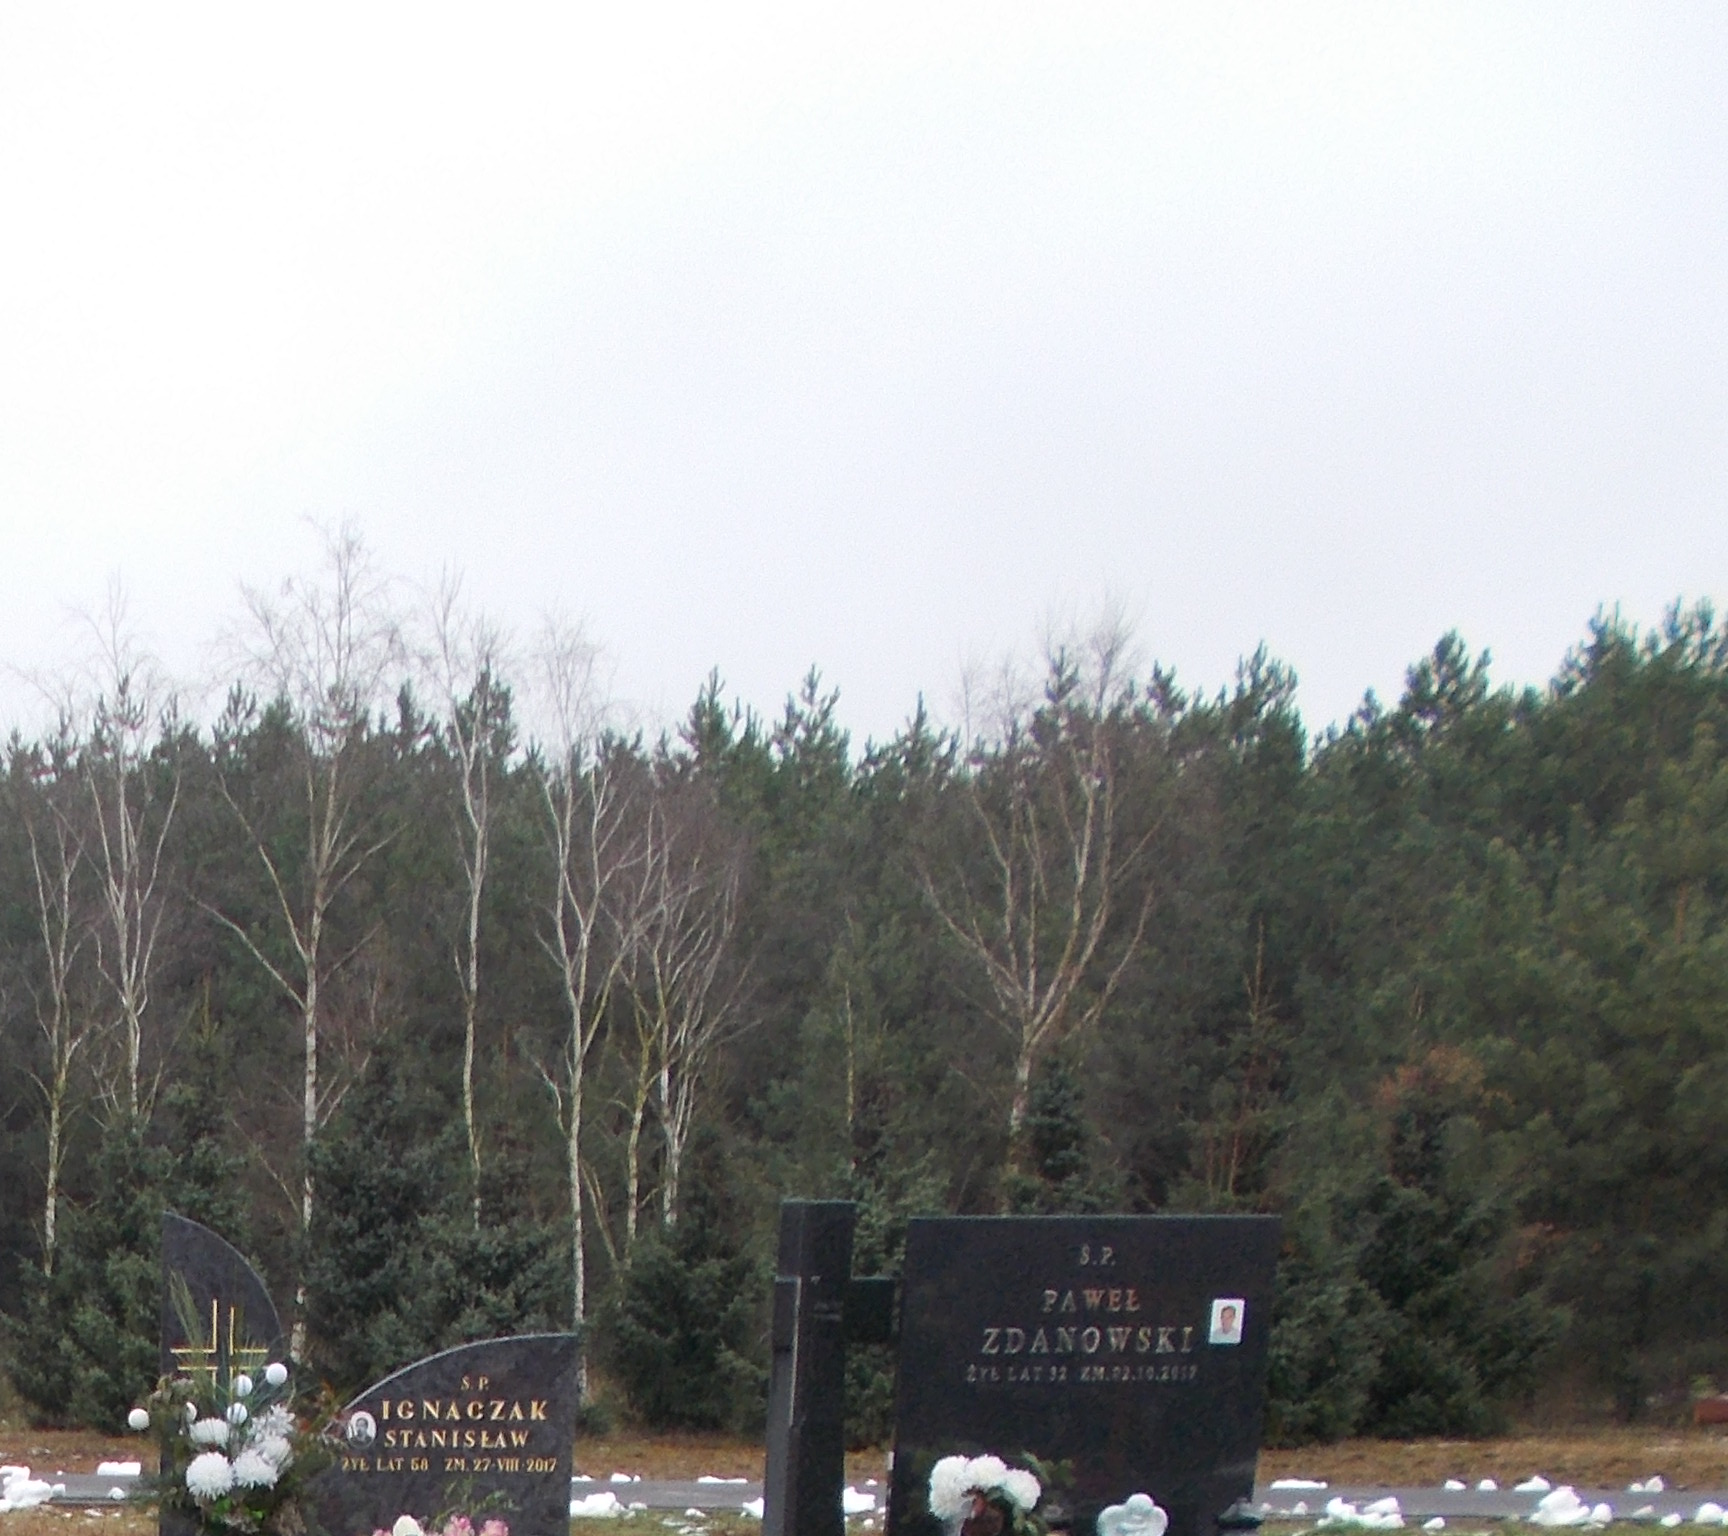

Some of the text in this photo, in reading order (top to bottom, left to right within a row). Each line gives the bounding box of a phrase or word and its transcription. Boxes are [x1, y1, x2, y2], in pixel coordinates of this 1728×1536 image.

[1041, 1289, 1141, 1313] PAWEŁ
[981, 1326, 1195, 1355] ZDANOWSKI
[1007, 1365, 1043, 1382] LAT
[381, 1399, 547, 1422] IGNACZAK
[384, 1429, 530, 1449] STANISŁAW
[376, 1456, 404, 1472] LAT
